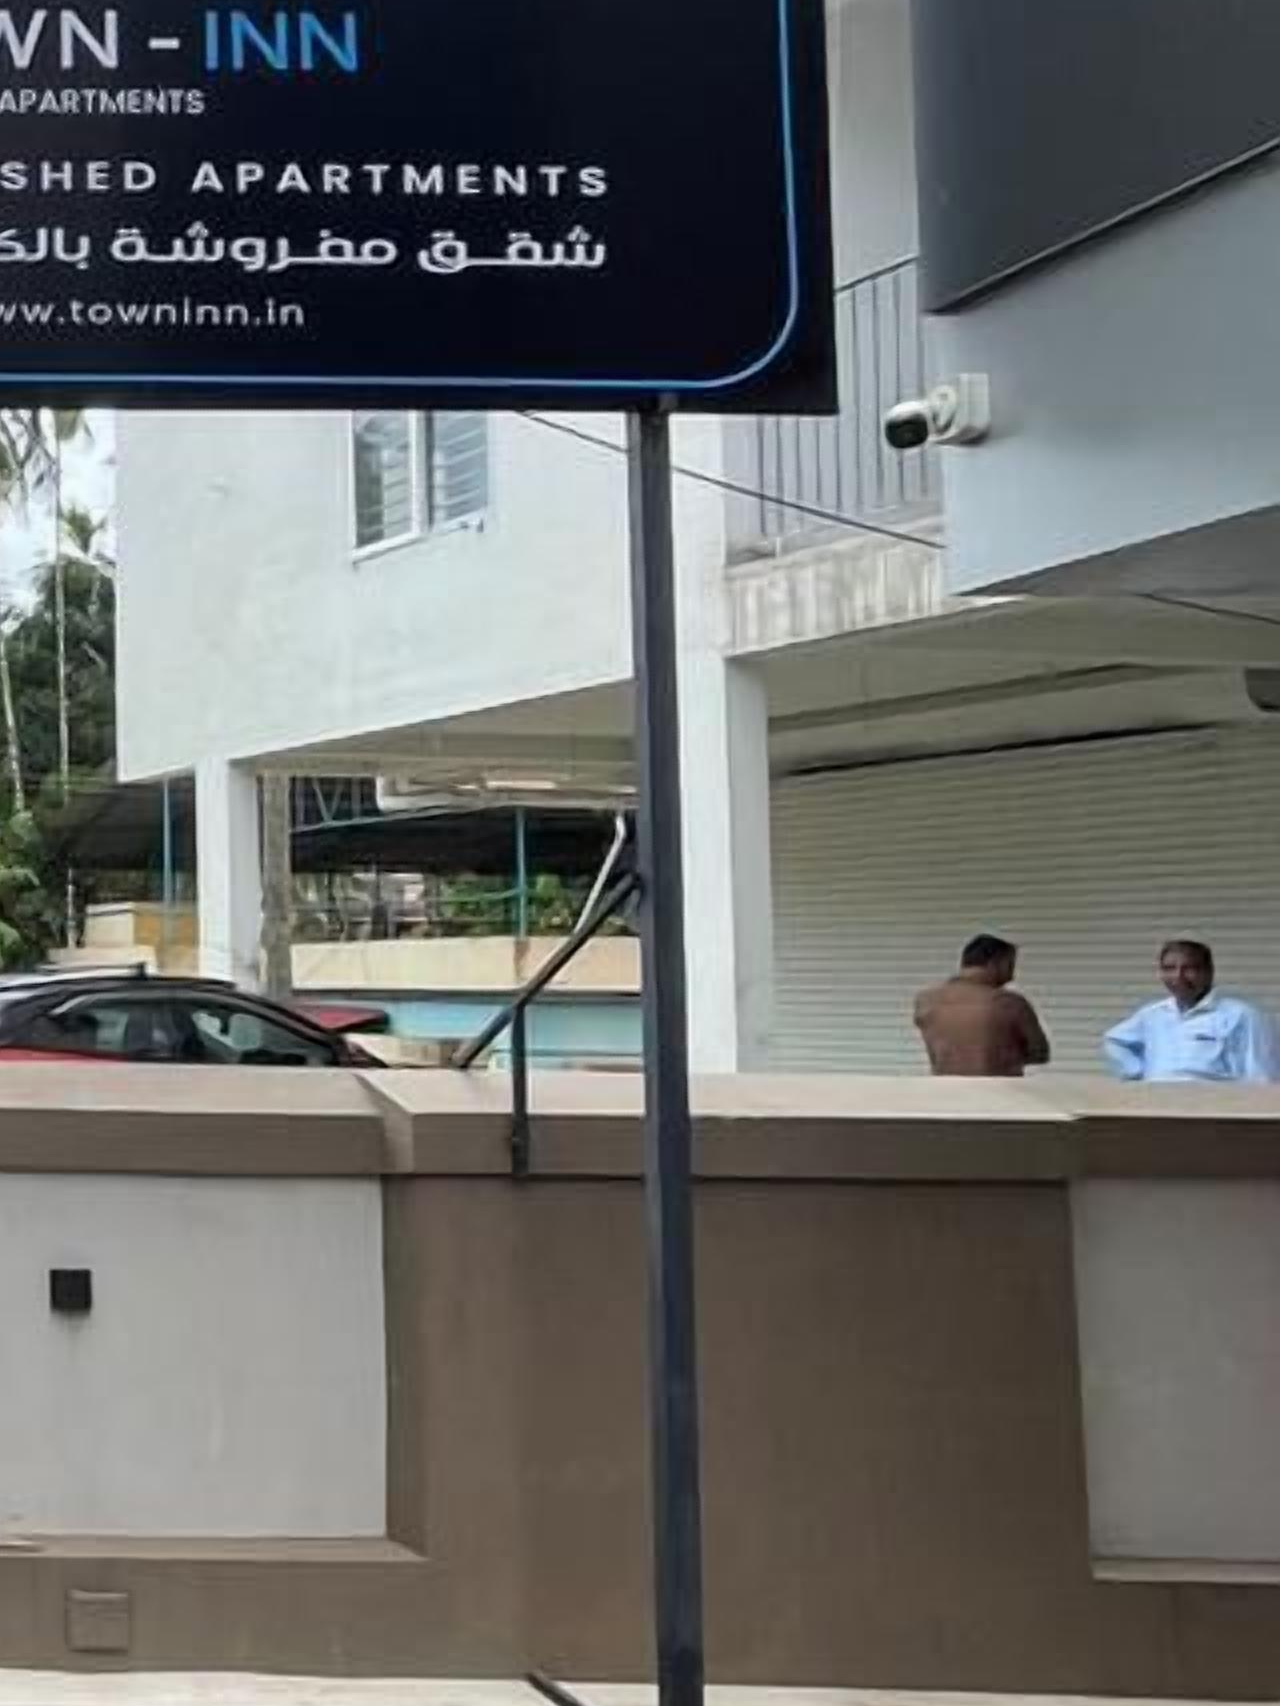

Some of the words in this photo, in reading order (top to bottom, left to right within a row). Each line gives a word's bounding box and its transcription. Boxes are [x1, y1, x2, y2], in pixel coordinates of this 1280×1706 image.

[205, 10, 359, 71] INN
[190, 161, 608, 197] APARTMENTS
[109, 220, 398, 272] مفروشة
[417, 224, 607, 274] شقق
